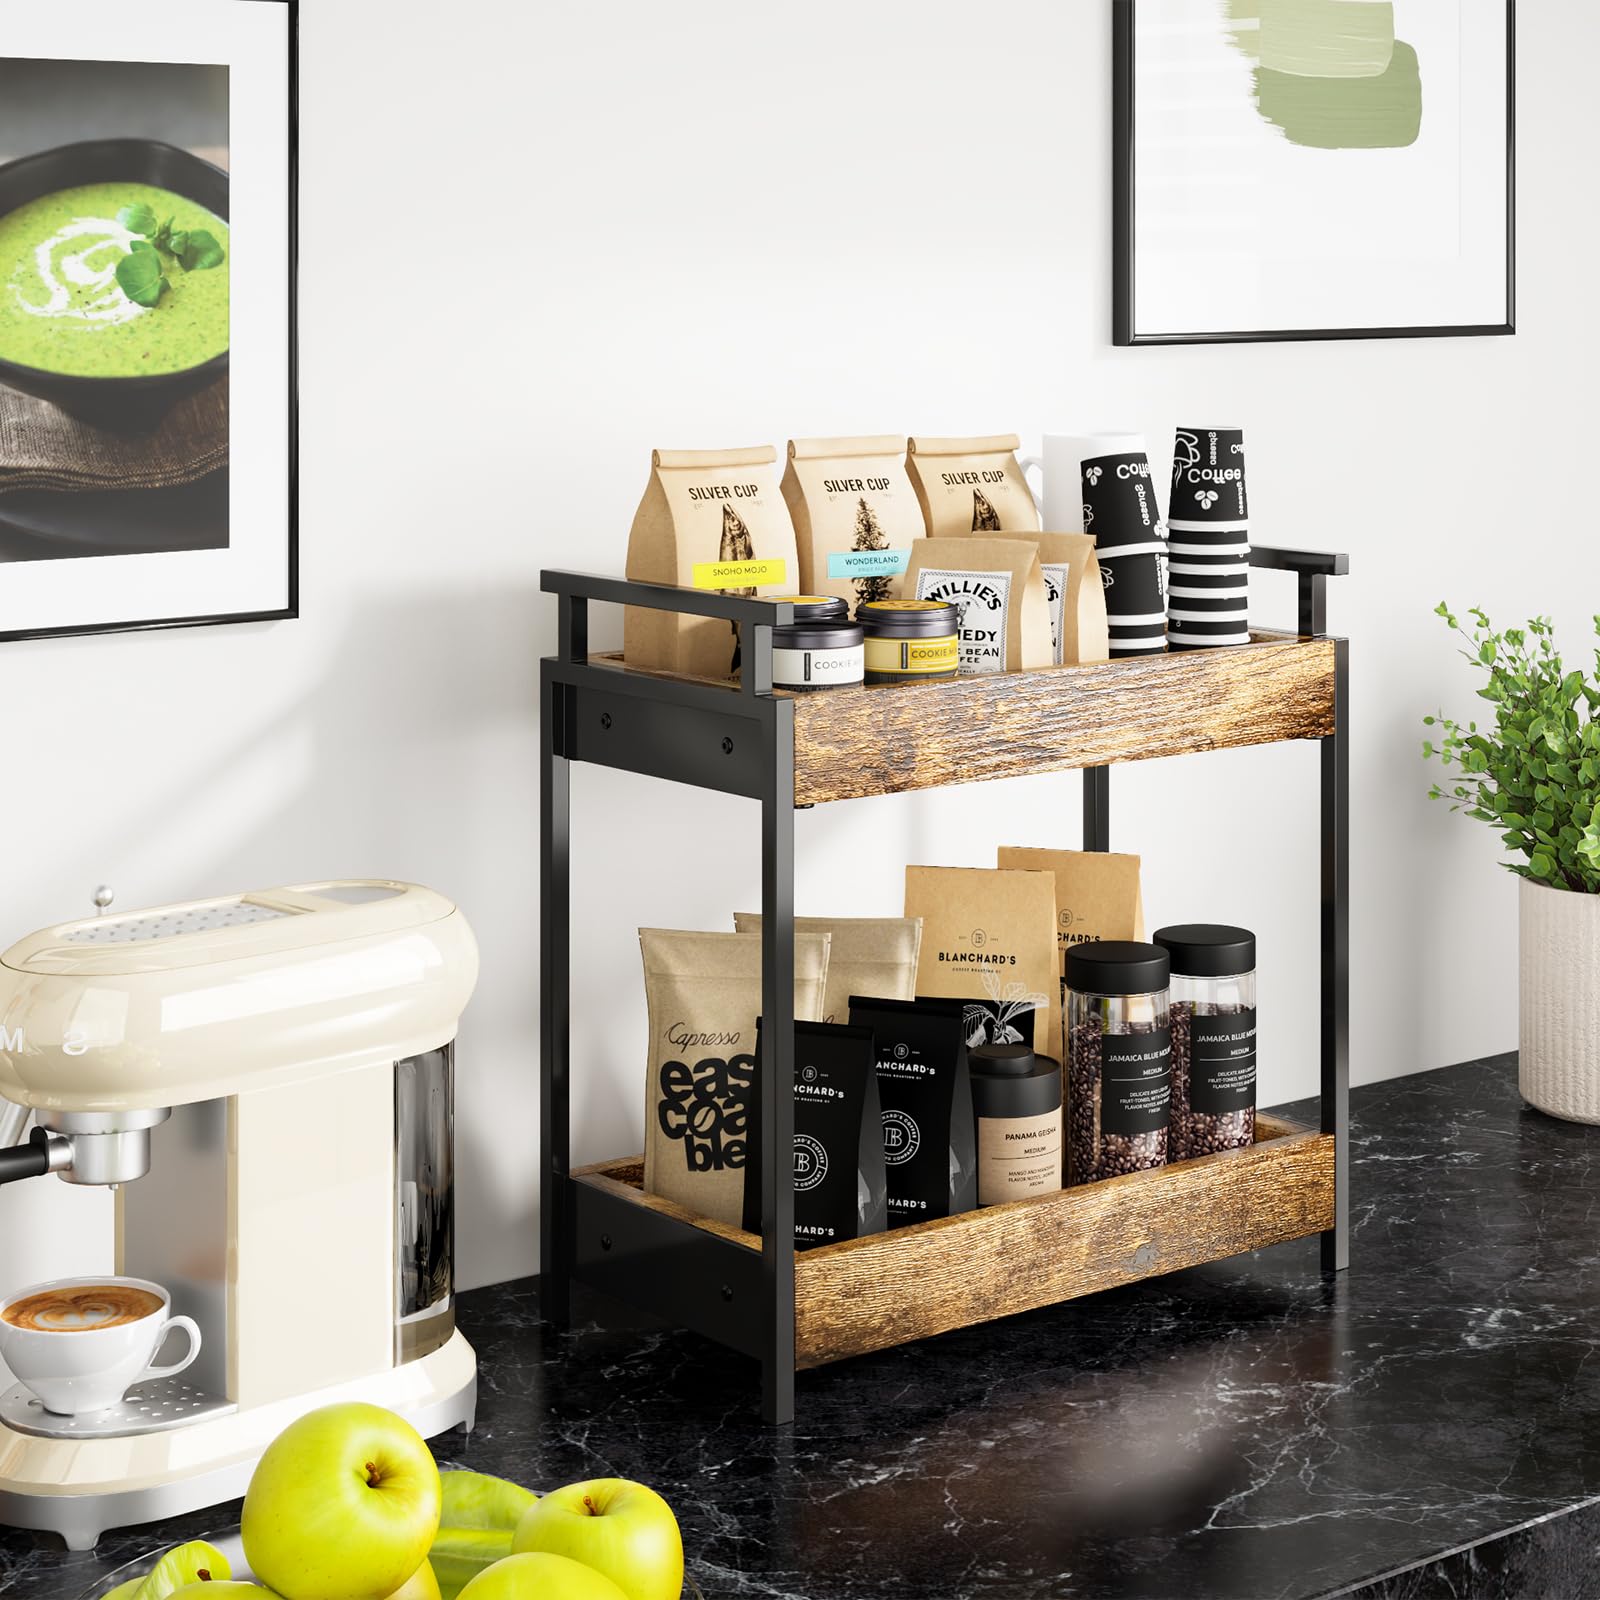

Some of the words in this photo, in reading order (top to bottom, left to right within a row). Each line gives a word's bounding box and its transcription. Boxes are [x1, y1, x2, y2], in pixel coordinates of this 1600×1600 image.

[942, 472, 980, 485] SILVER
[982, 470, 1004, 483] CUP
[824, 479, 865, 492] SILVER
[867, 478, 890, 490] CUP
[689, 486, 731, 500] SILVER
[734, 485, 758, 497] CUP
[845, 556, 899, 566] WONDERLAND
[713, 568, 742, 576] SNOHO
[745, 566, 767, 574] MOJO
[924, 581, 1001, 610] WILLIE'S
[912, 649, 946, 658] COOKIE
[966, 648, 999, 657] BEAN
[1058, 932, 1100, 943] CHARD'S
[939, 952, 1016, 965] BLANCHARD'S
[664, 1022, 740, 1053] Capresso
[1232, 1032, 1245, 1040] BLUE
[1144, 1052, 1158, 1060] BLUE
[1006, 1132, 1037, 1140] PANAMA
[1024, 1146, 1046, 1154] MEDIUM
[888, 1198, 927, 1208] HARD'S
[795, 1225, 835, 1236] HARD'S
